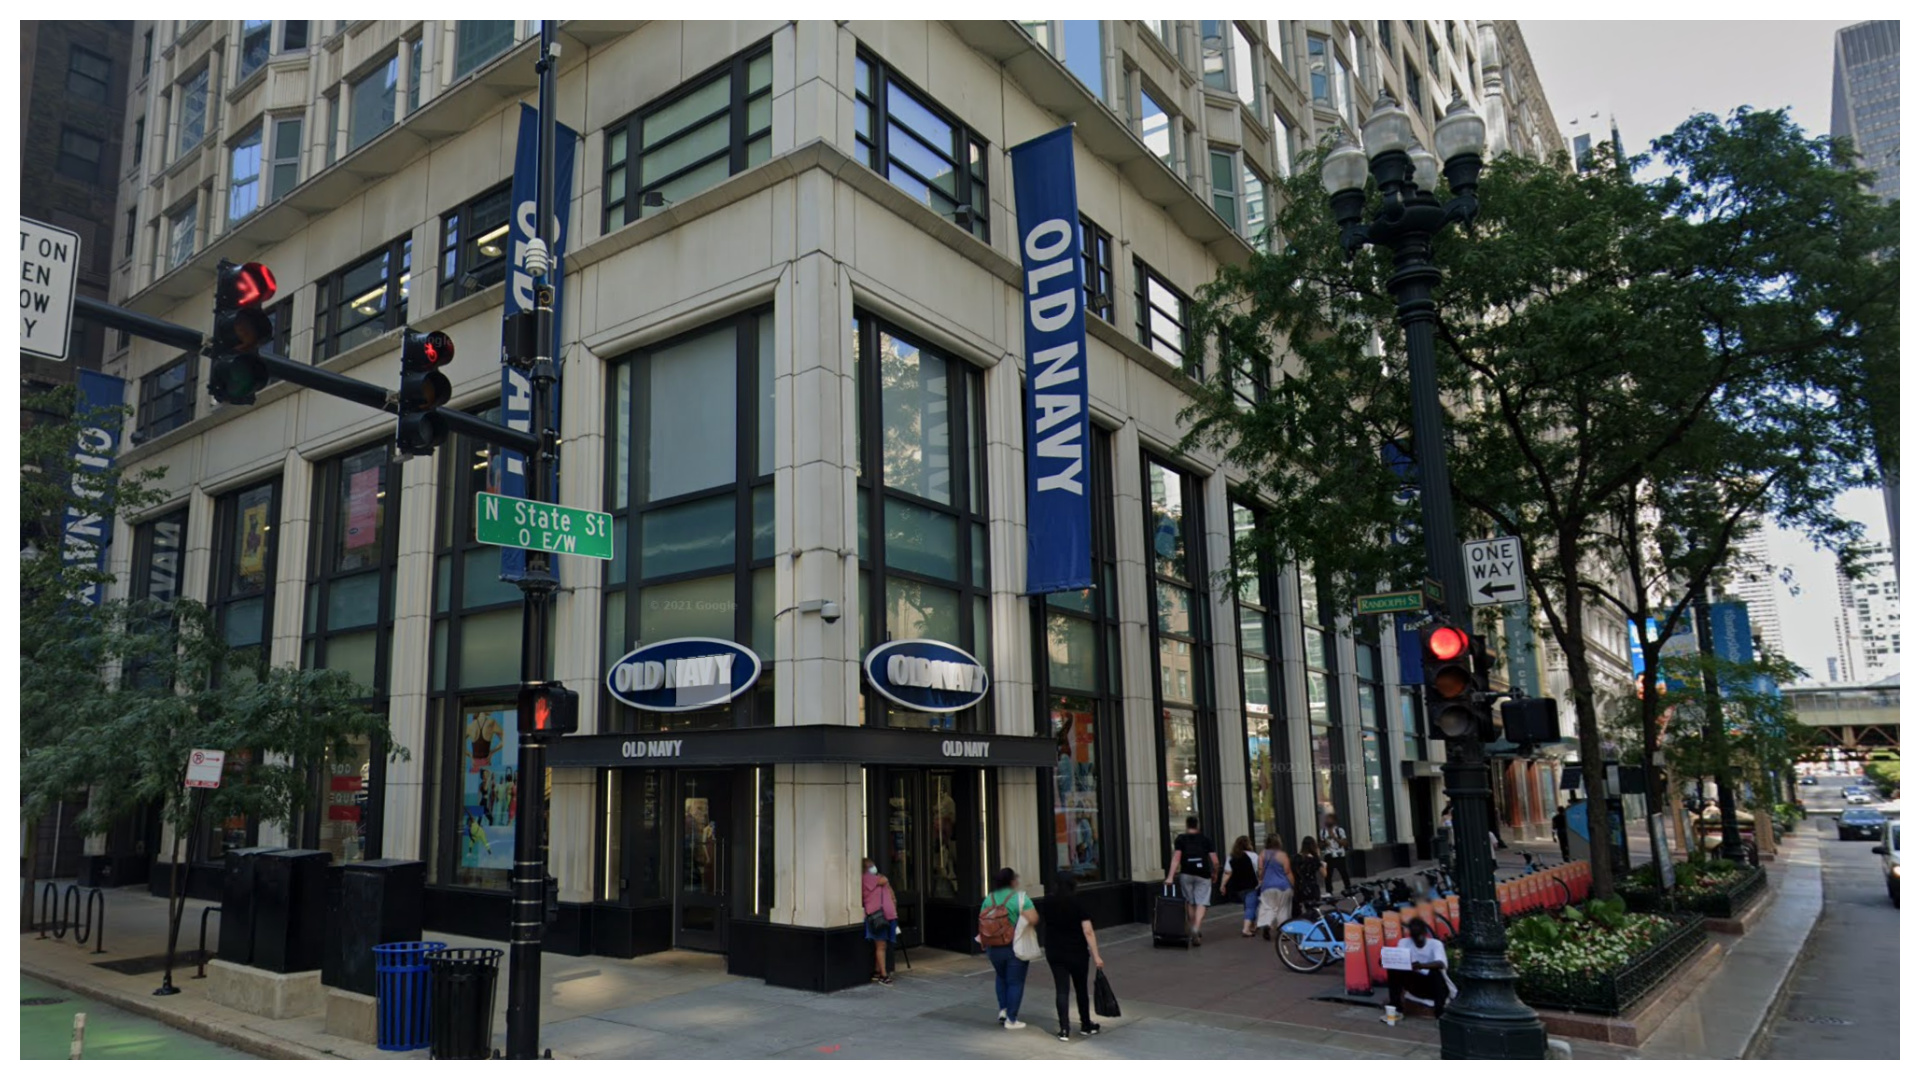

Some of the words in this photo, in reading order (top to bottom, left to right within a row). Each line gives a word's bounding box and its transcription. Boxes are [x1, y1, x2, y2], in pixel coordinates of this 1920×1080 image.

[38, 238, 68, 263] ON
[1025, 218, 1076, 333] OLD
[1033, 340, 1083, 496] NAVY
[485, 496, 499, 521] N
[514, 501, 571, 532] State
[585, 513, 605, 538] St
[542, 531, 576, 553] E/W
[1471, 543, 1513, 562] ONE
[1472, 560, 1514, 580] WAY
[615, 661, 665, 693] OLD
[665, 652, 737, 690] NAVY
[887, 654, 932, 689] OLD
[931, 659, 984, 694] NAVY
[622, 741, 647, 758] OLD
[648, 740, 683, 757] NAVY
[942, 740, 963, 757] OLD
[964, 741, 990, 758] NAVY
